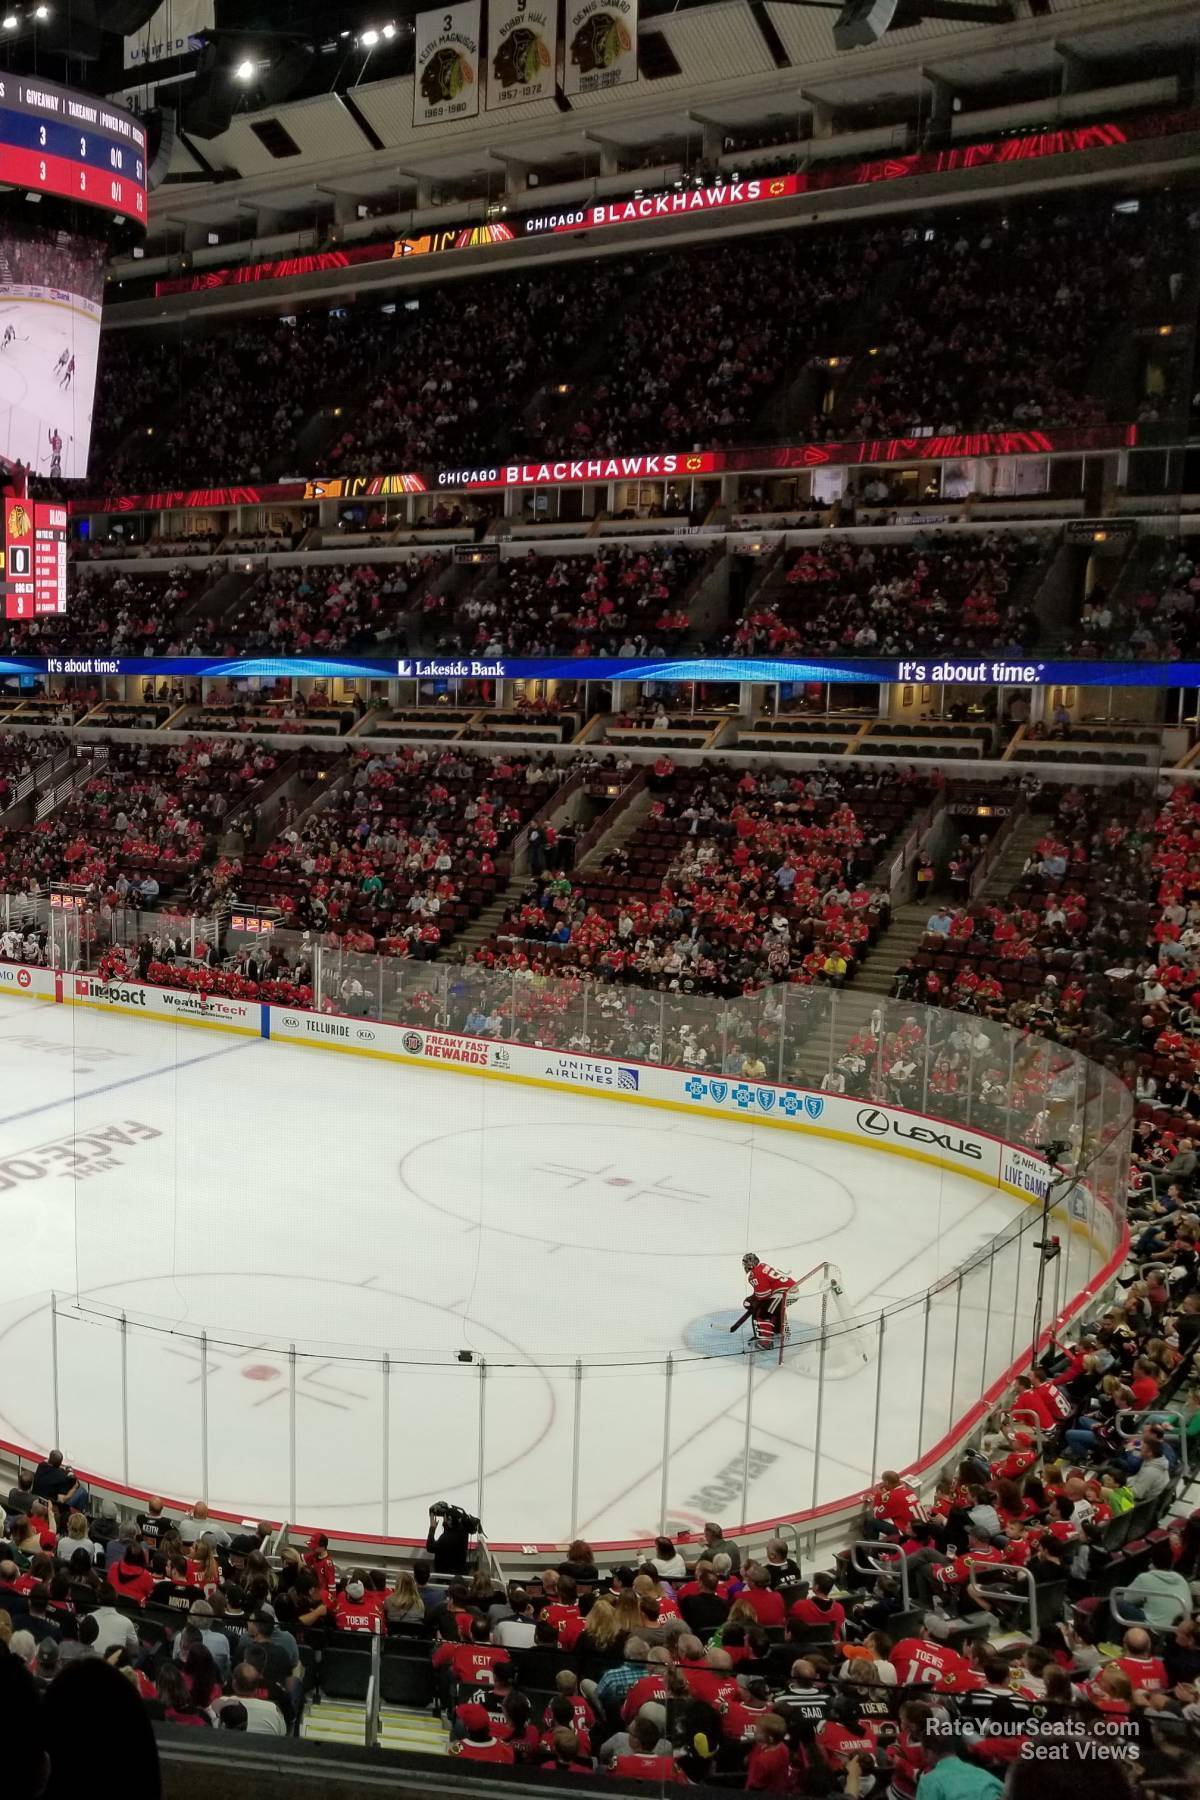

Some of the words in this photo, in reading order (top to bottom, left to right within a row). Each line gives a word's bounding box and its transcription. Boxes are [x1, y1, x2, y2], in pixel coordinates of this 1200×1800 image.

[443, 15, 453, 32] 3
[573, 3, 598, 26] DENIS
[500, 14, 525, 37] BOBBY
[527, 12, 547, 27] HULL
[130, 37, 184, 60] UNITED
[418, 40, 438, 65] KEITH
[439, 33, 477, 55] MAGNUSON
[499, 83, 542, 101] 1957-1972
[26, 89, 59, 112] GIVEAWAY
[68, 101, 98, 124] TAKEAWAY
[39, 125, 47, 146] 3
[110, 147, 123, 169] 0/0
[39, 160, 47, 181] 3
[526, 211, 584, 231] CHICAGO
[593, 181, 762, 224] BLACKHAWKS
[438, 469, 497, 485] CHICAGO
[506, 455, 678, 483] BLACKHAWKS
[15, 549, 25, 573] 0
[17, 597, 24, 614] 3
[47, 659, 61, 673] It's
[64, 659, 92, 673] about
[415, 661, 469, 676] Lakeside
[471, 661, 505, 676] Bank
[931, 661, 987, 681] about
[306, 1020, 350, 1038] TELLURIDE
[425, 1034, 464, 1049] FREAKY
[465, 1041, 490, 1052] FAST
[424, 1045, 488, 1065] REWARDS
[545, 1067, 614, 1085] AIRLINES
[558, 1059, 613, 1075] UNITED
[893, 1120, 983, 1160] LEXUS
[1004, 1164, 1023, 1187] LIVE
[142, 1523, 159, 1537] KEITH
[168, 1595, 190, 1609] MIKITA
[345, 1615, 369, 1626] TOEWS
[915, 1648, 945, 1669] TOEWS
[800, 1706, 823, 1719] SAAD
[859, 1702, 889, 1715] TOEWS
[839, 1739, 873, 1750] CRAWFORD
